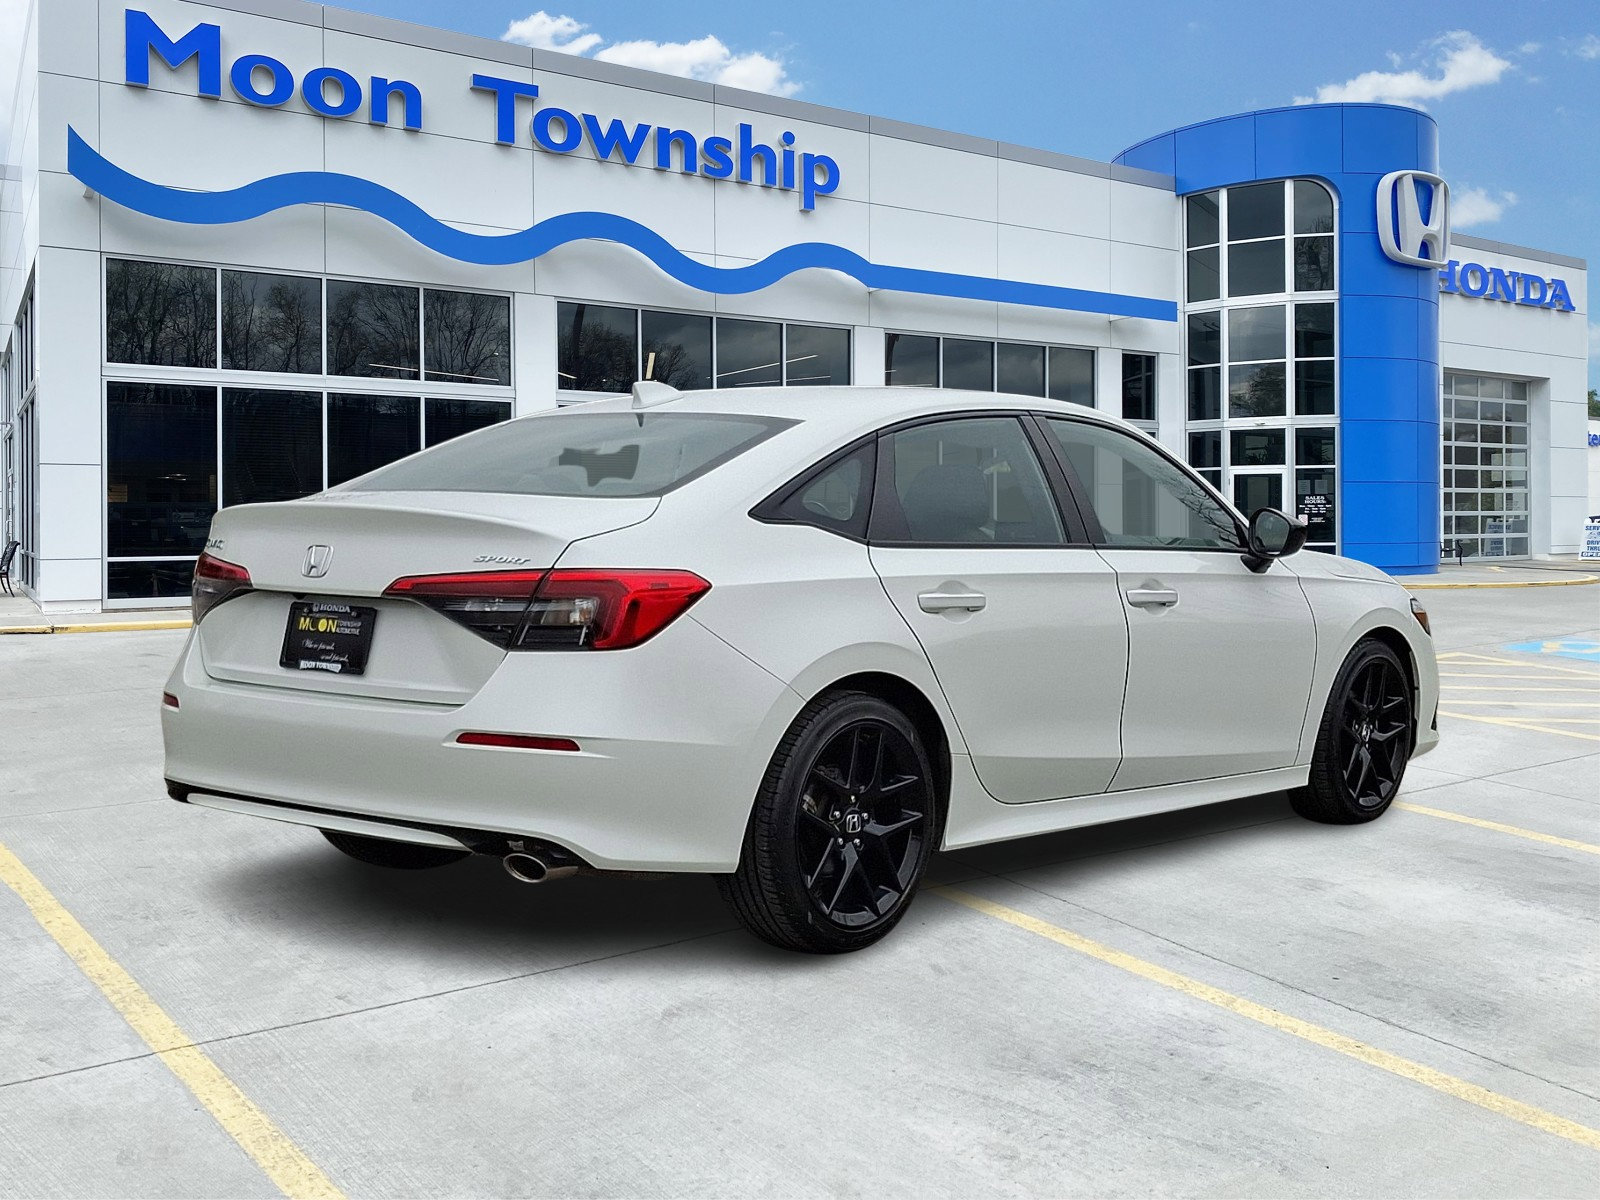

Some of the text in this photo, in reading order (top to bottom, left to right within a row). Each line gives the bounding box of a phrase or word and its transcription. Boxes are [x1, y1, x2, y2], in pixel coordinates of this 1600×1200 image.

[125, 9, 841, 213] Moon Township
[473, 554, 531, 565] SPORT
[320, 604, 350, 612] HONDA
[299, 617, 337, 632] MOON
